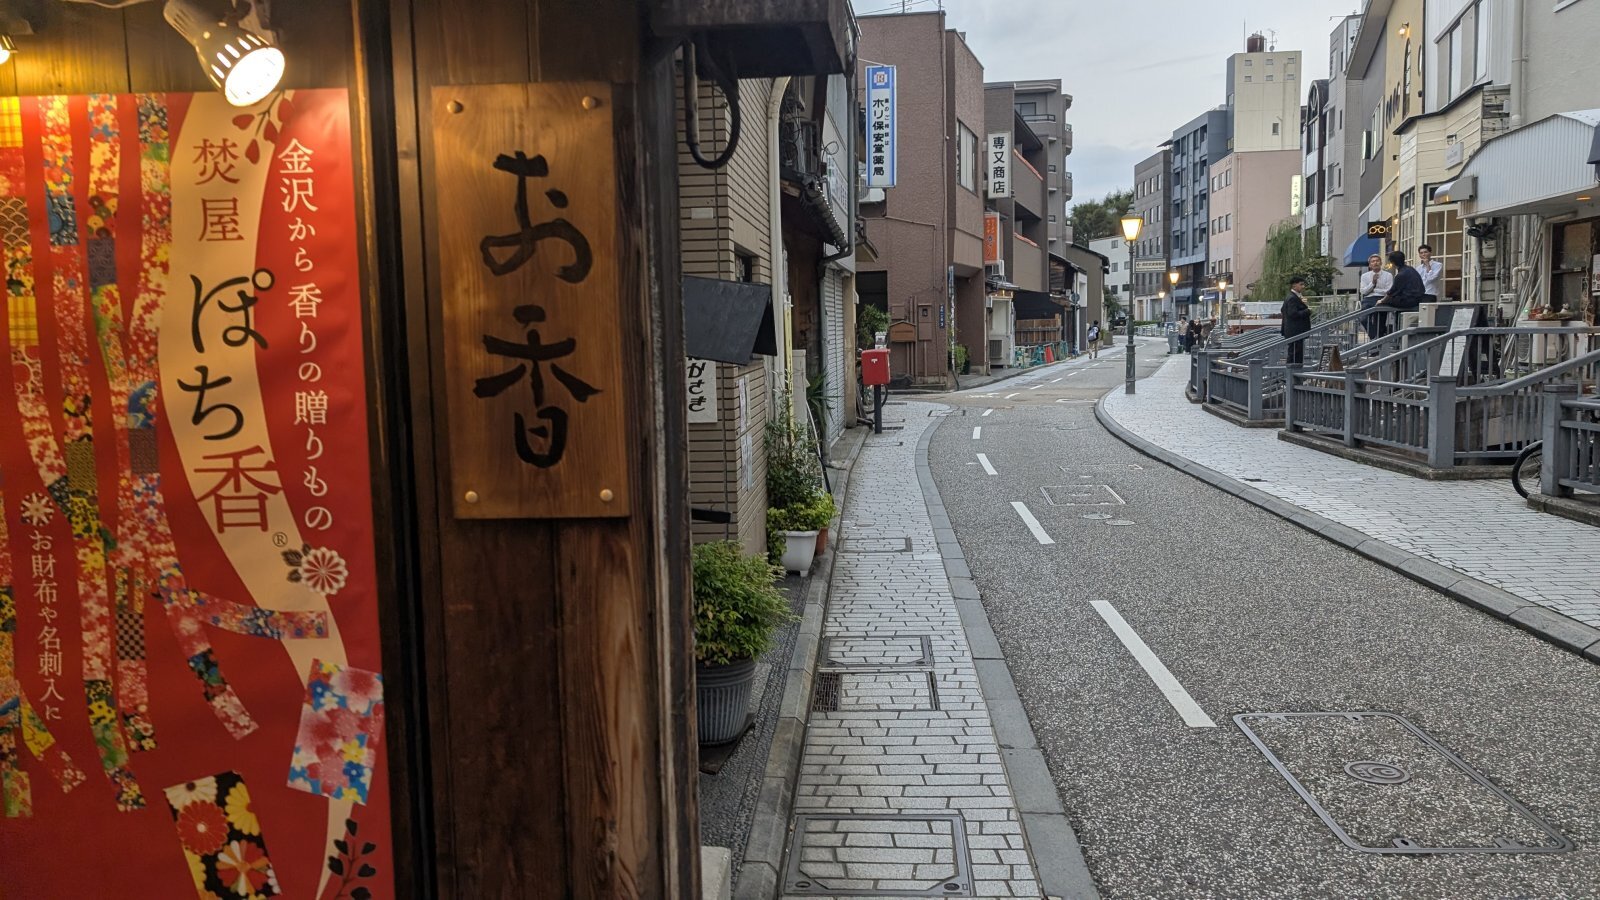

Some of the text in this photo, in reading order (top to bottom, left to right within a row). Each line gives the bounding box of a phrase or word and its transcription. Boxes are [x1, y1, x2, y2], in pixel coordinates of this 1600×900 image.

[872, 98, 885, 176] ホリ保安堂薬局
[177, 138, 284, 534] 焚屋 ぽち香
[278, 138, 333, 530] 金沢から香りの贈りもの
[473, 150, 603, 468] お香
[687, 355, 707, 412] かさき
[29, 530, 65, 720] お財布や名刺入に
